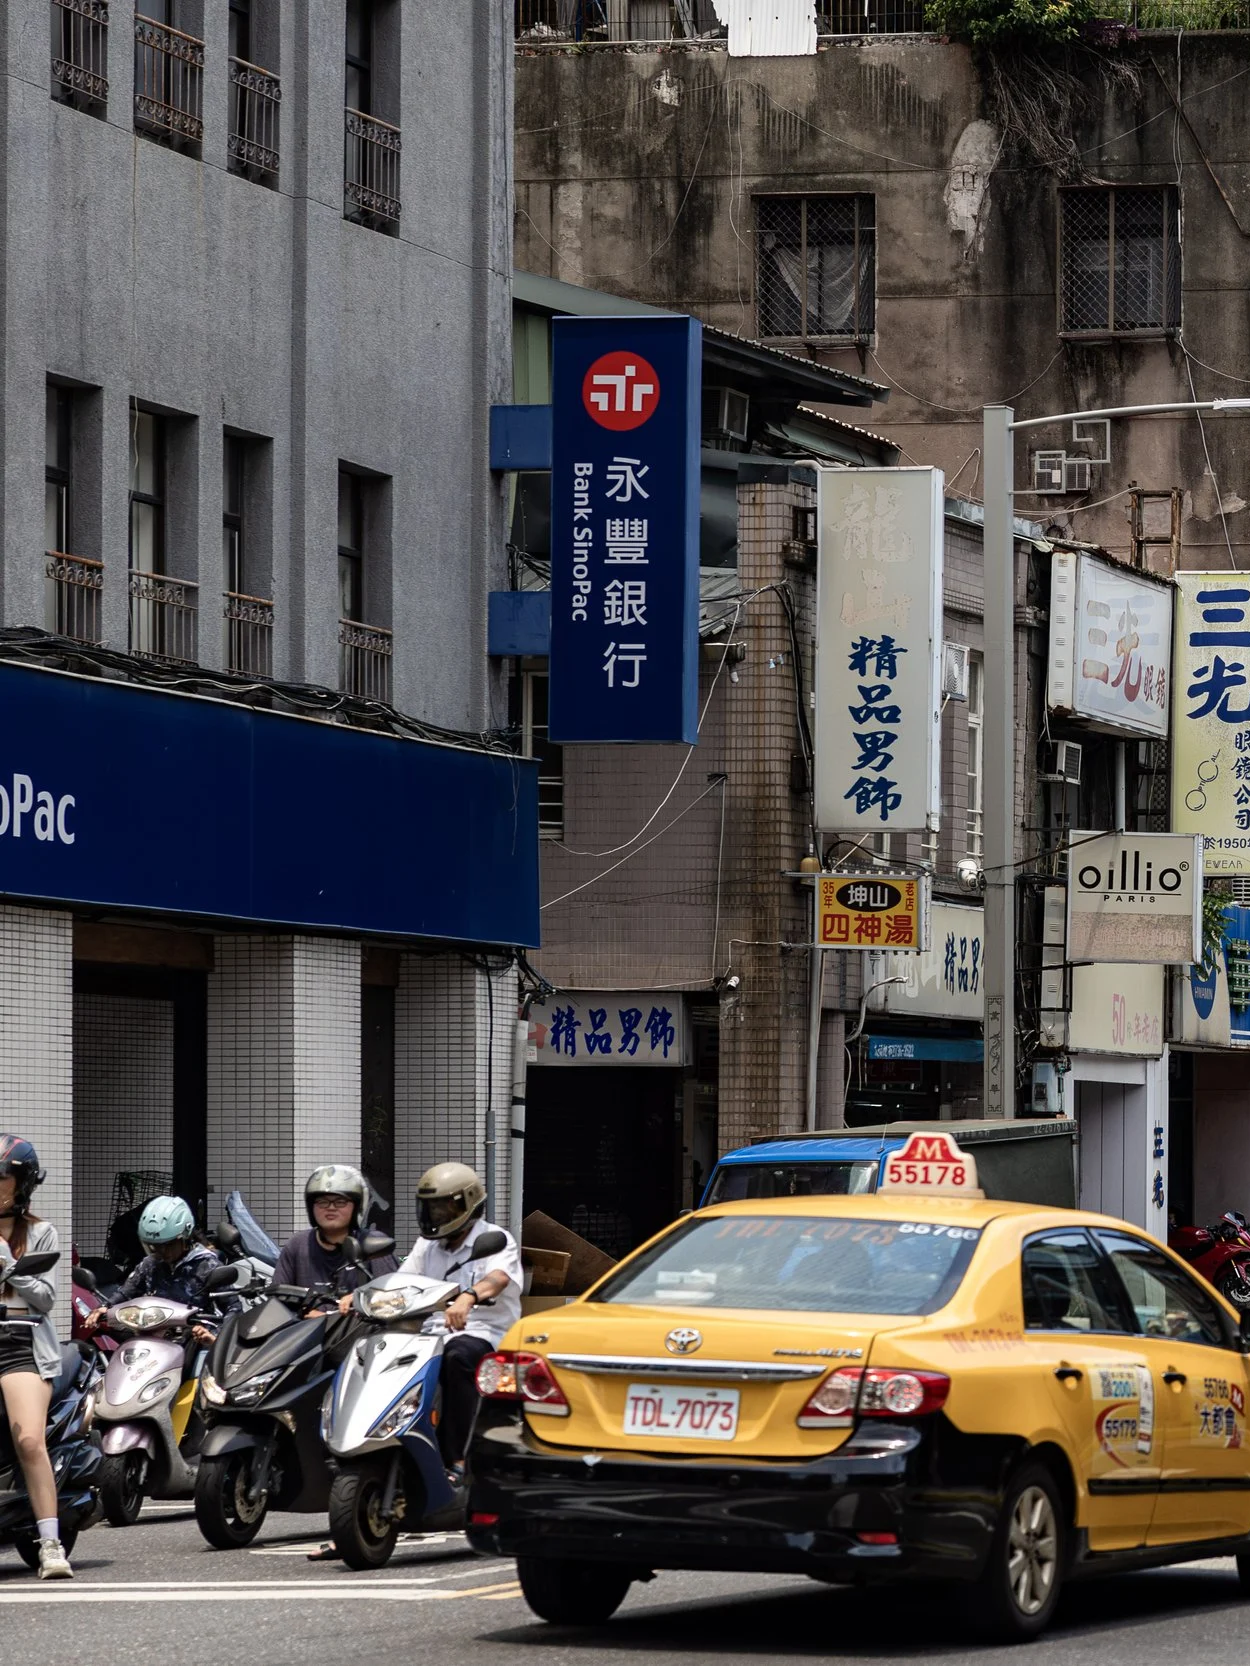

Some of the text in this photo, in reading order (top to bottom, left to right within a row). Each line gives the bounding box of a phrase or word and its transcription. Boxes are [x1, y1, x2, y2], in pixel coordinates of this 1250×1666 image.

[572, 462, 593, 622] Bank SinoPac
[602, 455, 650, 689] 永豐銀行
[1078, 850, 1181, 891] oillio
[1203, 859, 1243, 869] EWEAR
[822, 881, 835, 909] 35年
[847, 884, 889, 907] 坤山
[905, 882, 915, 911] 老店
[1104, 894, 1156, 903] PARIS
[822, 913, 914, 944] 四神湯
[914, 1140, 947, 1161] M
[889, 1164, 966, 1186] 55178
[629, 1396, 735, 1431] TDL-7073
[1105, 1419, 1137, 1439] 55178
